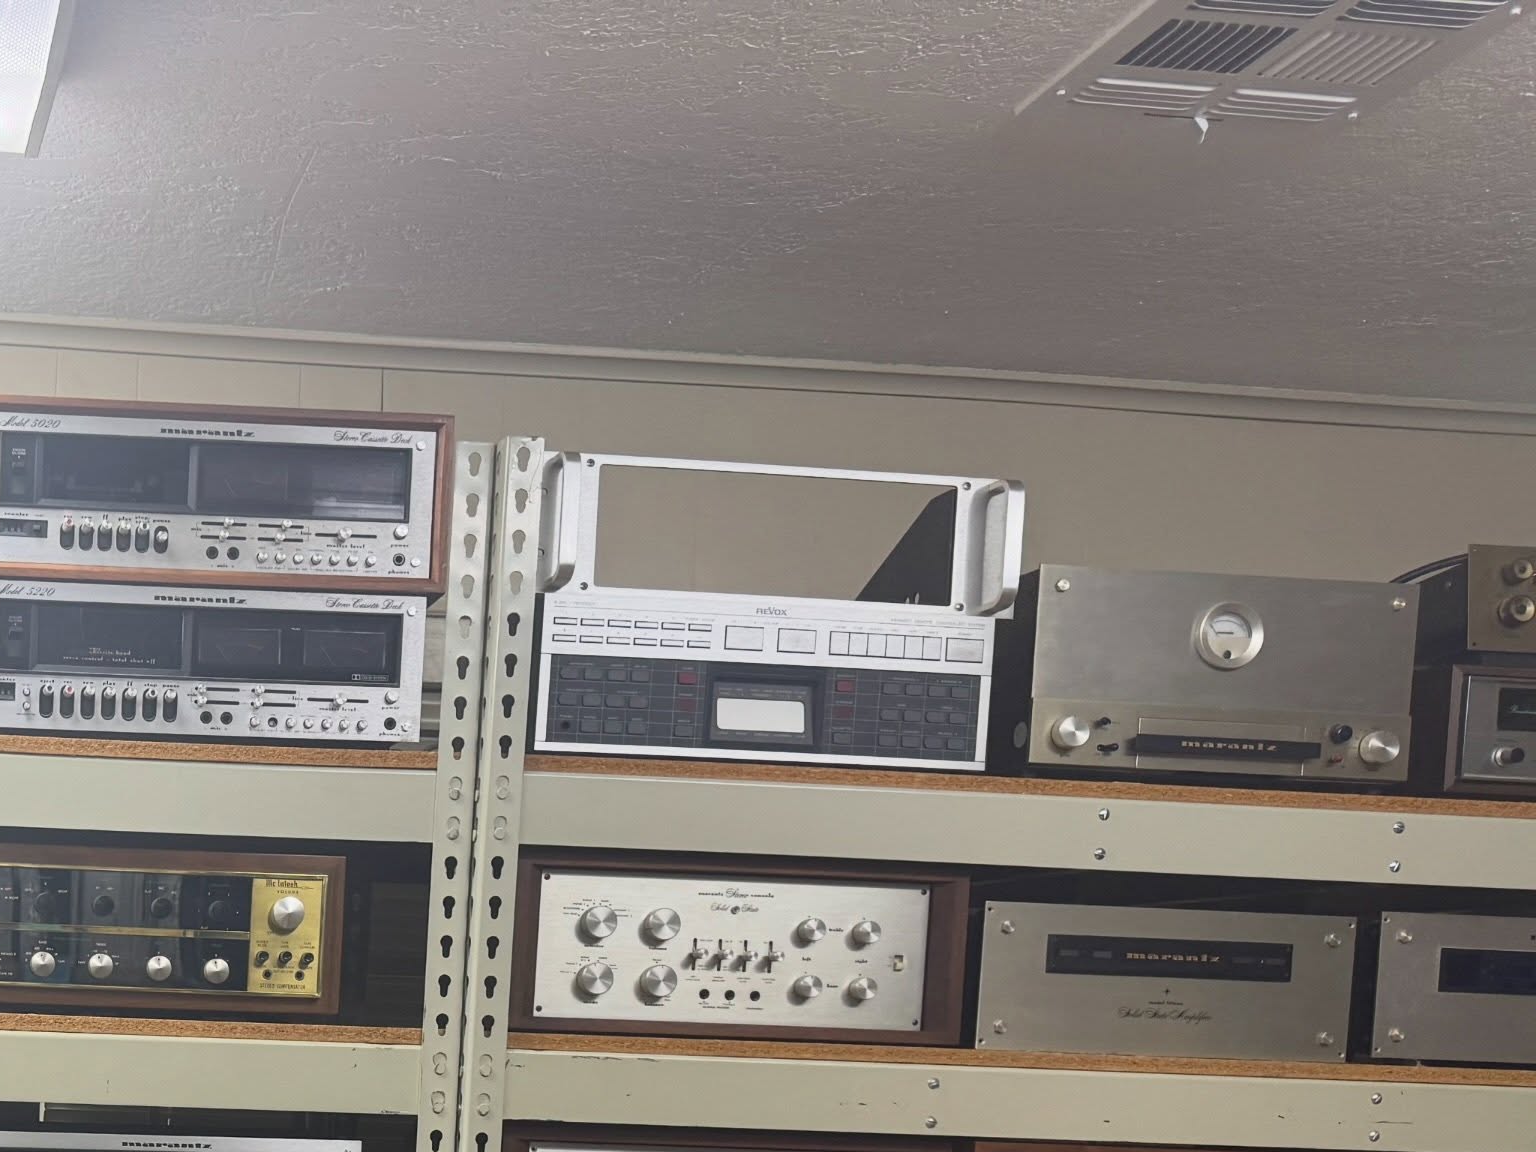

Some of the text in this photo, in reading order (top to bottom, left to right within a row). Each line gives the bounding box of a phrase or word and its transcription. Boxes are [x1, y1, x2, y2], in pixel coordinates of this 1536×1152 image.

[0, 415, 62, 429] Model 5020
[333, 429, 359, 443] Stereo
[358, 431, 389, 444] Cassette
[25, 586, 56, 597] 5220
[324, 598, 405, 610] Stereo Cassette Deck
[1180, 739, 1278, 753] marantz
[1125, 952, 1221, 964] marantz
